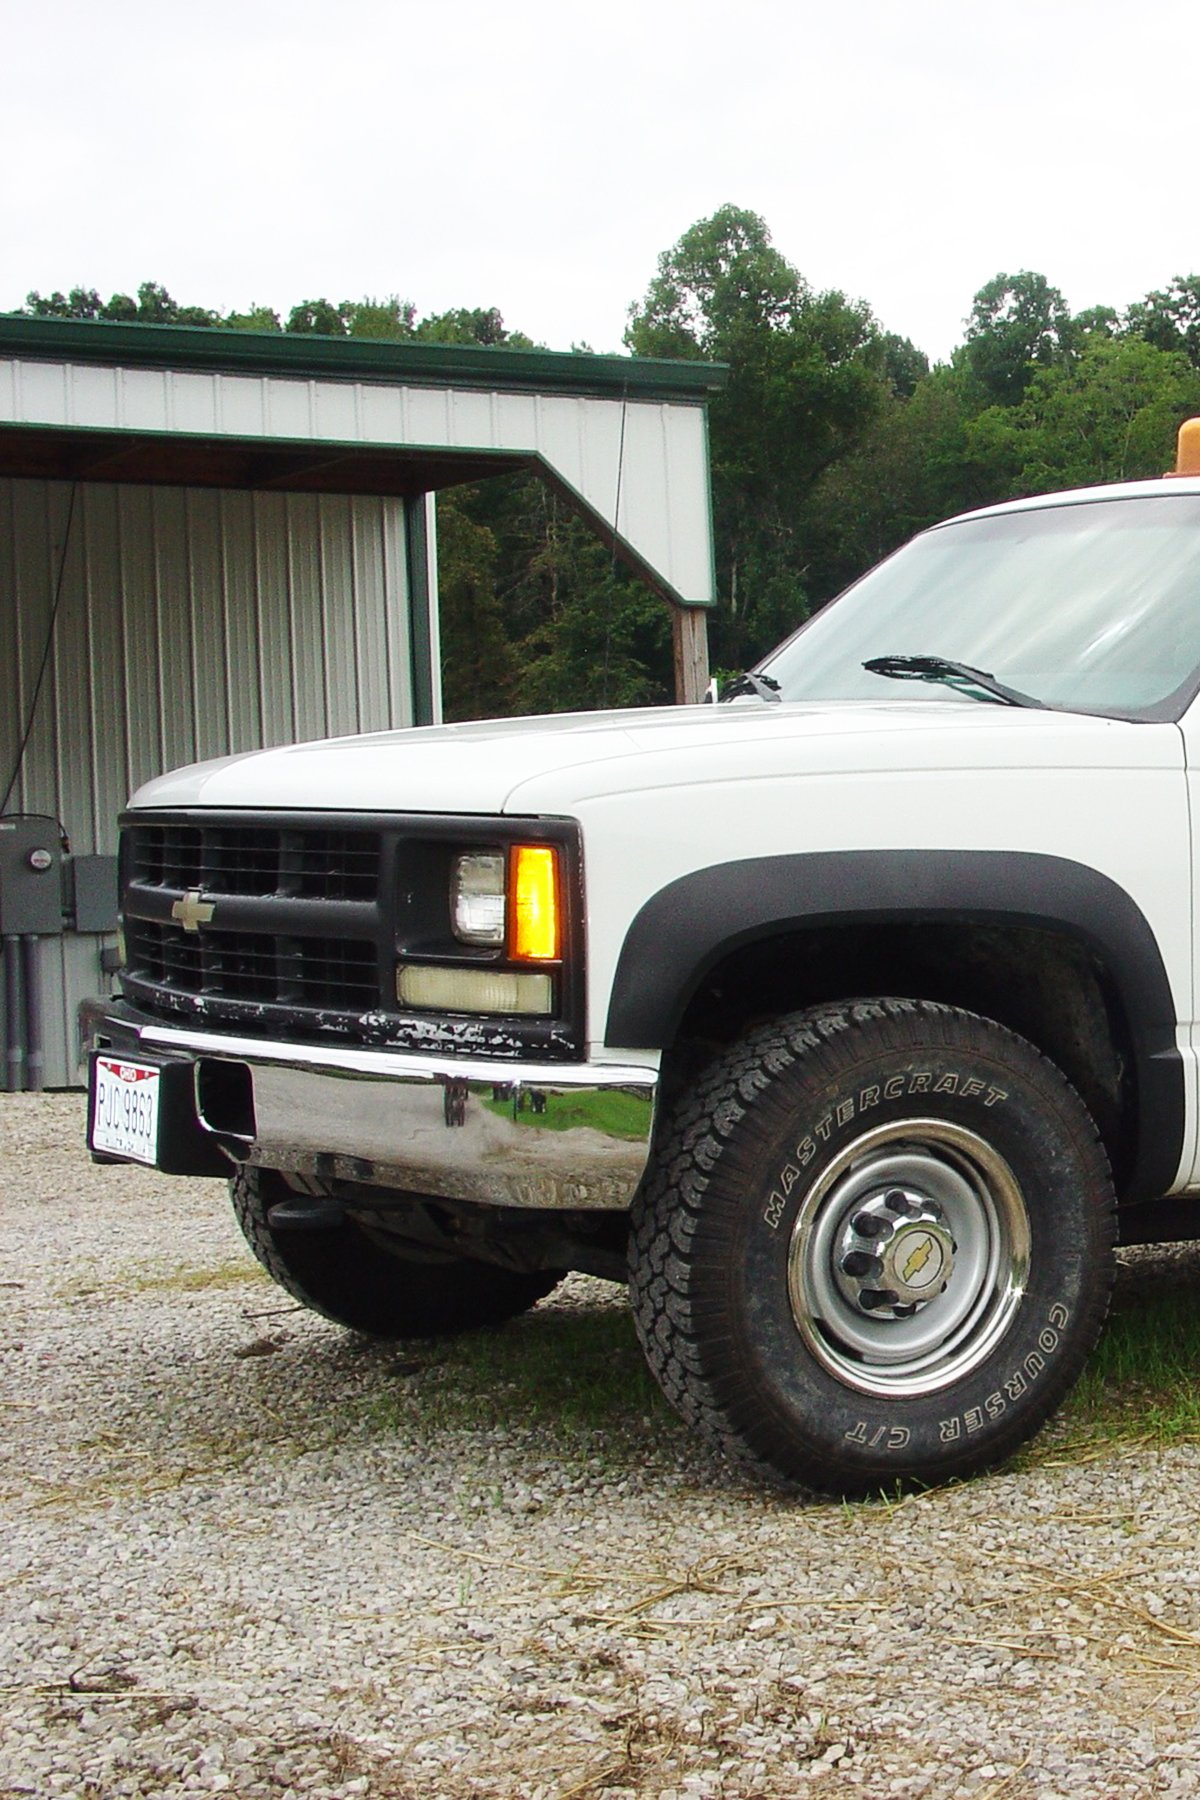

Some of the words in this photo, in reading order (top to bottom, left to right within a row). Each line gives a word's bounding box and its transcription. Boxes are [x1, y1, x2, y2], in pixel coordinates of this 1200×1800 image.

[120, 1066, 137, 1082] OHIO
[98, 1083, 120, 1128] PJC
[124, 1089, 152, 1138] 9863
[763, 1072, 1009, 1229] MASTERCRAFT
[939, 1302, 1069, 1443] COURSER
[844, 1420, 911, 1449] C/T
